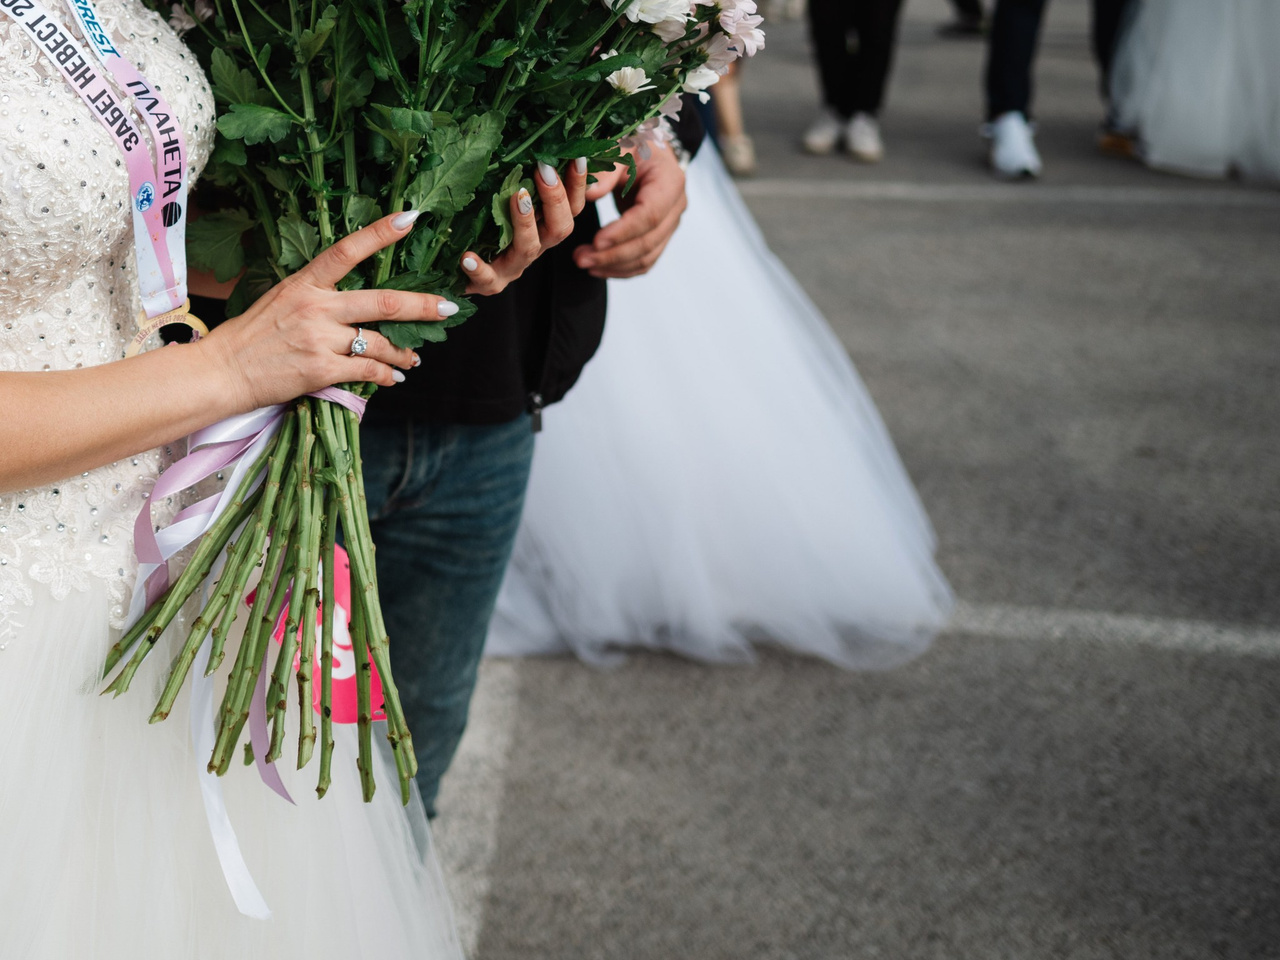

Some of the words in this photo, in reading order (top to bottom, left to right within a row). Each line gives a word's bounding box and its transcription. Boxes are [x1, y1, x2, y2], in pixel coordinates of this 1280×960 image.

[24, 14, 97, 90] НЕВЕСТ
[87, 83, 140, 153] ЗАБЕГ
[126, 79, 183, 199] ПЛАНЕТА
[135, 328, 151, 345] ЗАБЕГ
[151, 315, 172, 330] НЕВЕСТ
[172, 314, 187, 323] 2025
